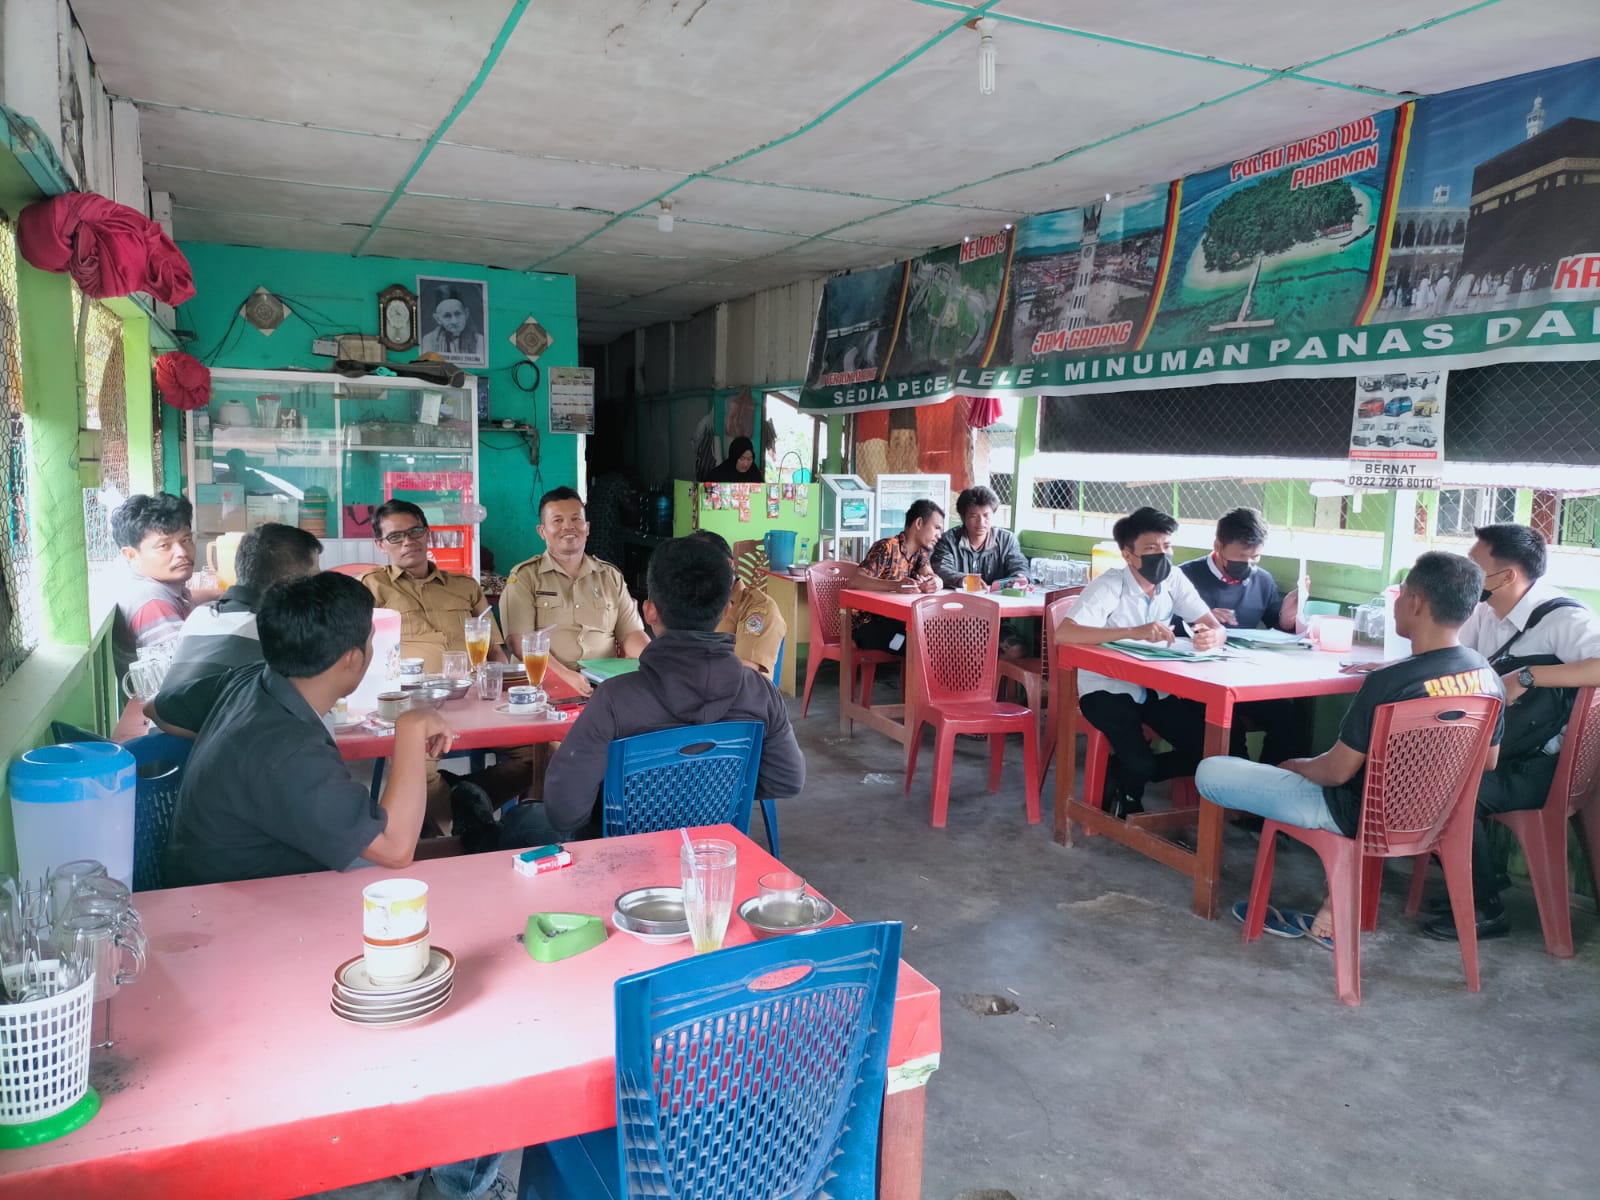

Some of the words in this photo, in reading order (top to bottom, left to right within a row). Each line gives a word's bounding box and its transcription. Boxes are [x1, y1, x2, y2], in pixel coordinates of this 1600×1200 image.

[1231, 148, 1284, 180] PULAU
[1286, 130, 1338, 165] ANGSO
[1291, 145, 1378, 190] PARIAMAN
[959, 234, 997, 262] KELOK
[998, 231, 1007, 252] 9
[1032, 329, 1066, 354] JAM
[1066, 321, 1132, 350] GADANG
[833, 384, 889, 405] SEDIA
[897, 375, 954, 398] PECE
[1064, 342, 1250, 382] MINUMAN
[1268, 322, 1455, 362] PANAS
[1485, 305, 1600, 346] DA
[1349, 476, 1376, 487] 0822
[1379, 477, 1404, 488] 7226
[1407, 479, 1433, 489] 8010
[1365, 464, 1416, 475] BERNAT
